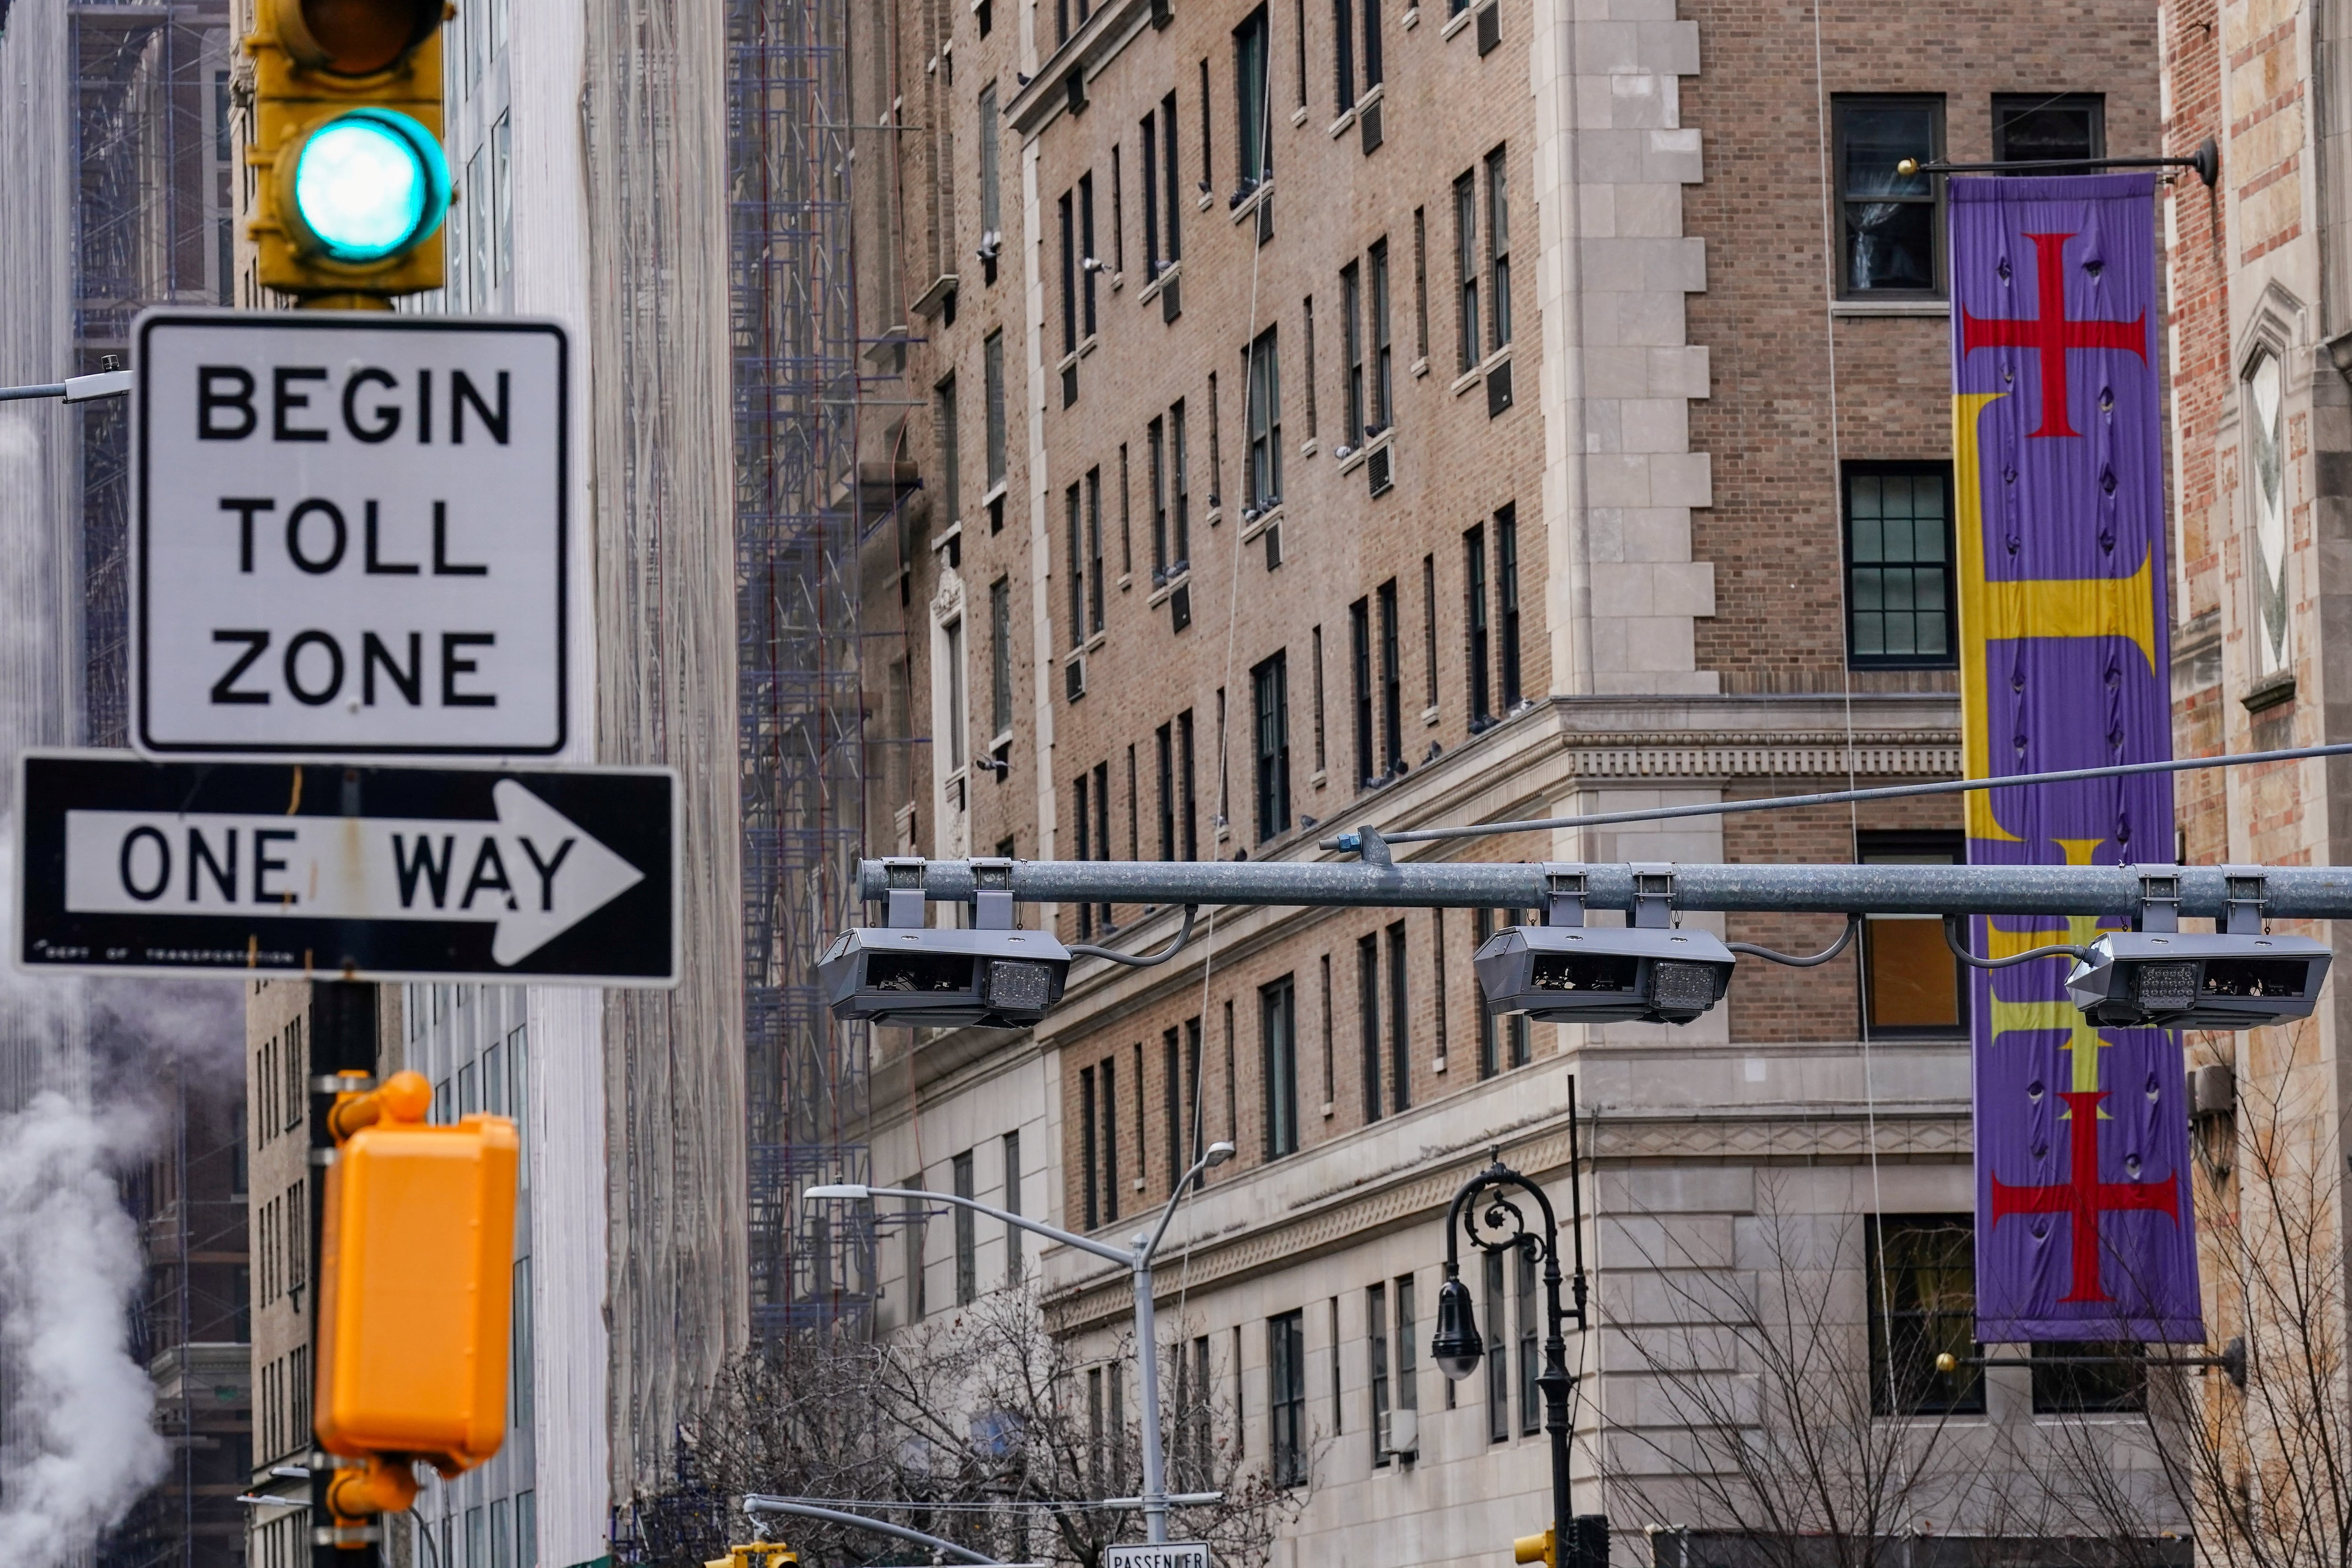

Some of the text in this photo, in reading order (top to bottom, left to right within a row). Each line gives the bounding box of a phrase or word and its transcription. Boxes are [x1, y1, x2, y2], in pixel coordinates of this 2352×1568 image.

[196, 364, 511, 446] BEGIN
[217, 497, 489, 577] TOLL
[209, 629, 498, 708] ZONE
[119, 824, 577, 913] ONE WAY
[105, 948, 129, 959] OF
[1114, 1553, 1202, 1568] PASSENER
